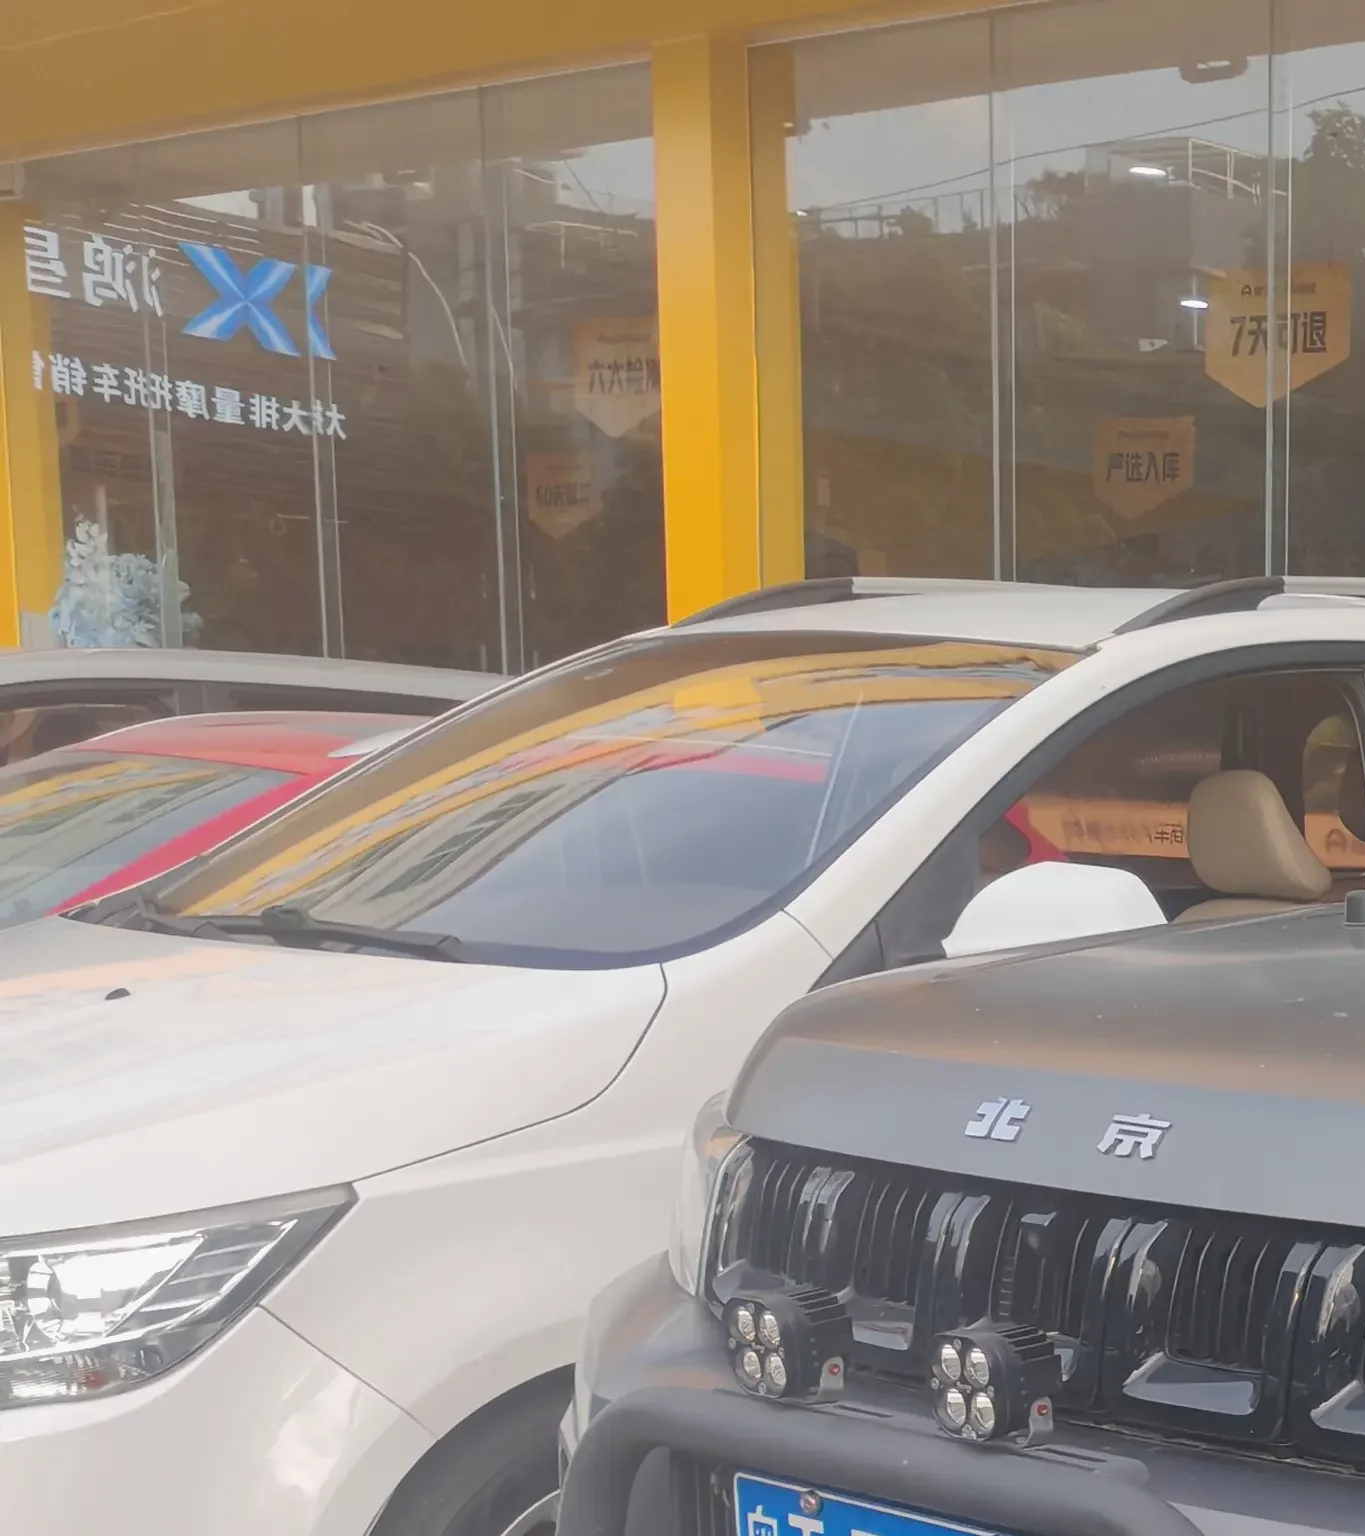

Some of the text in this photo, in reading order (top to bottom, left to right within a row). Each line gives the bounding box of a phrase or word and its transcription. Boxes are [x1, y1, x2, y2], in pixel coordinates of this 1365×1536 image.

[1107, 451, 1181, 483] 严选入库
[964, 1097, 1172, 1160] 北京
